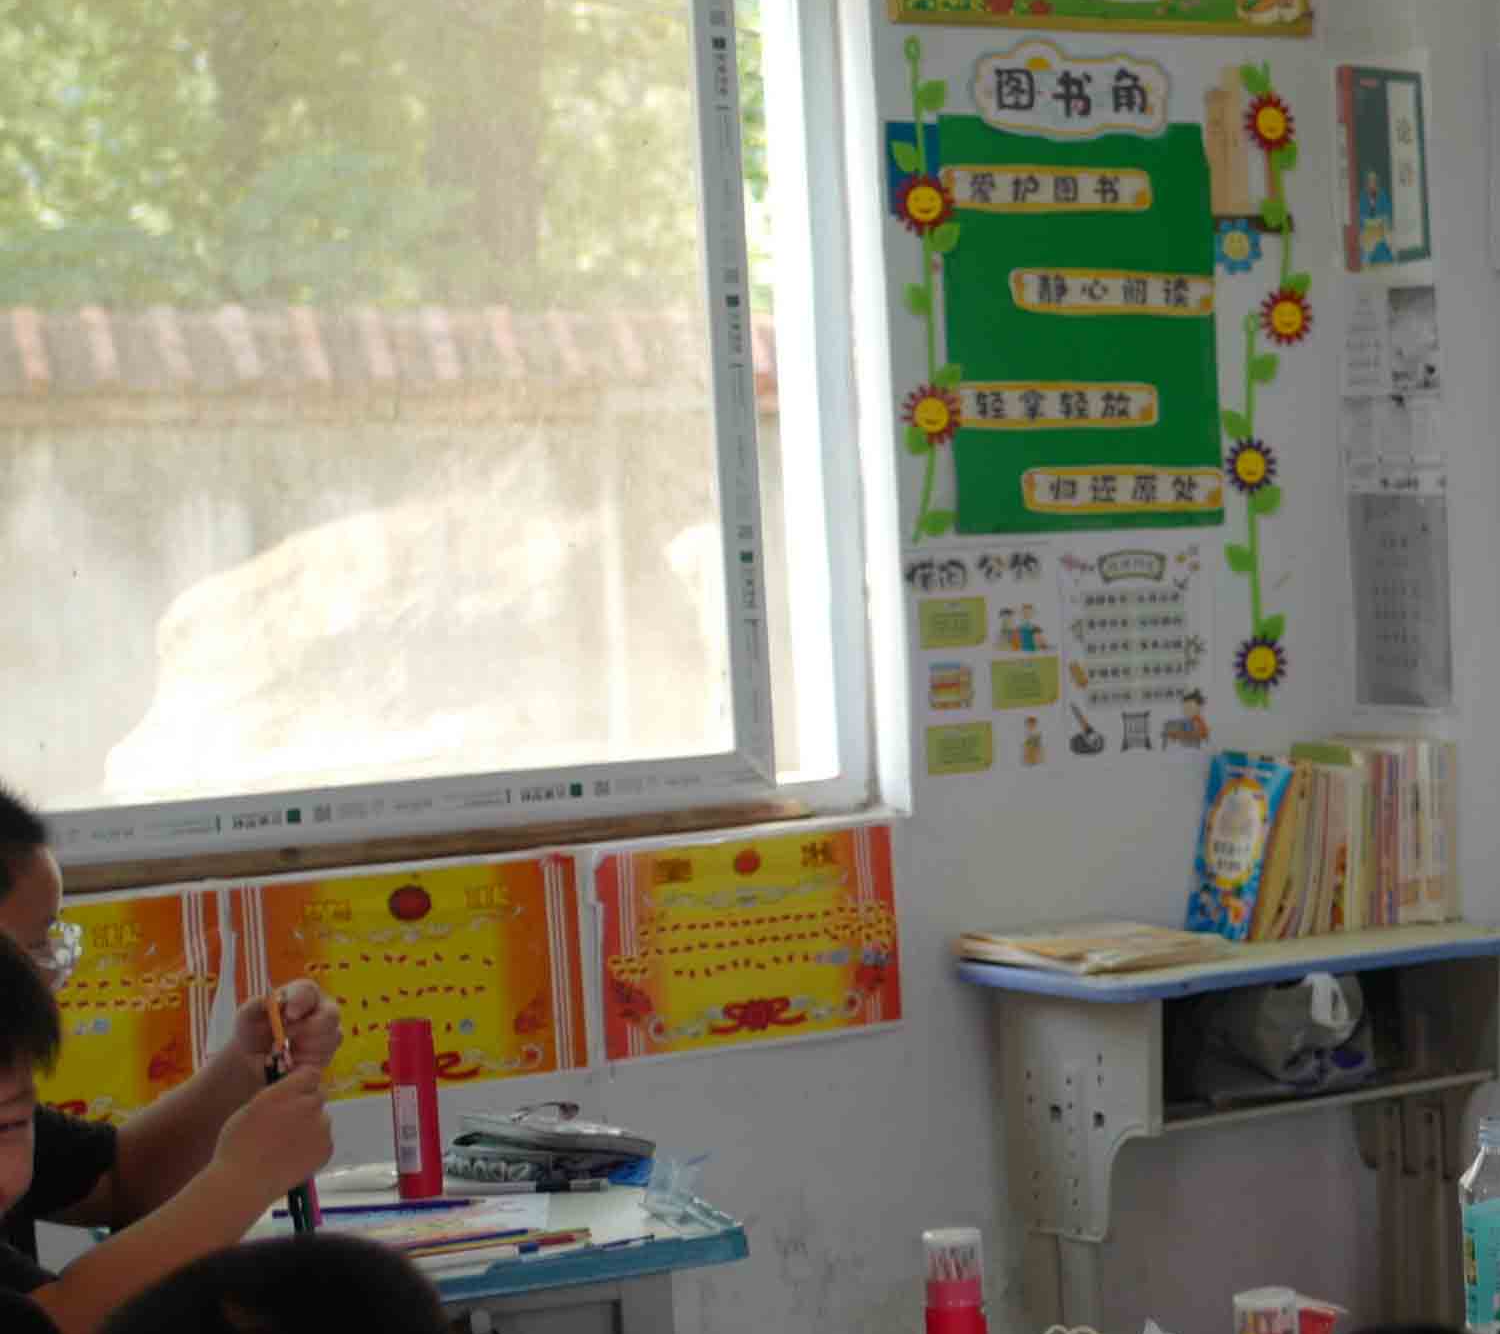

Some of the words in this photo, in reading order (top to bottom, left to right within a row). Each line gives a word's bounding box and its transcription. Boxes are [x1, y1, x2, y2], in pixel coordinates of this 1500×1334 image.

[996, 68, 1149, 118] 图书角
[969, 173, 1121, 205] 爱护图书
[976, 391, 1132, 422] 轻拿轻放
